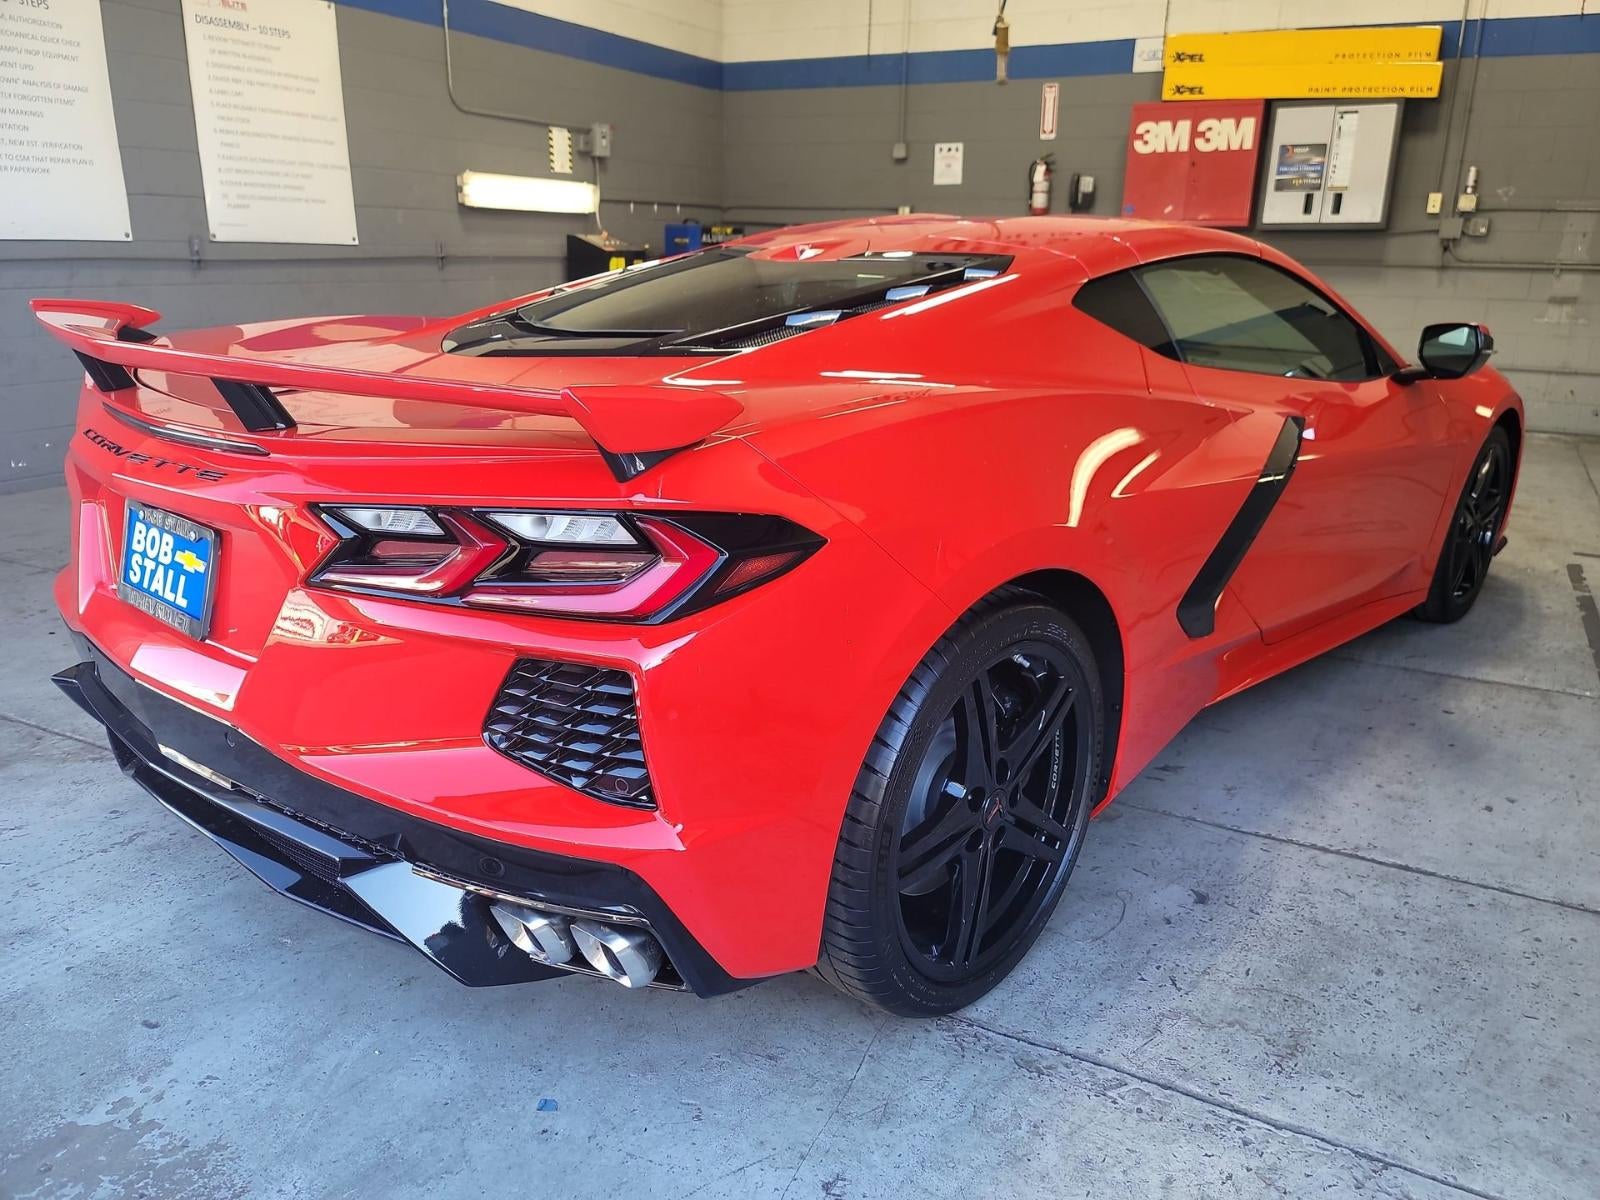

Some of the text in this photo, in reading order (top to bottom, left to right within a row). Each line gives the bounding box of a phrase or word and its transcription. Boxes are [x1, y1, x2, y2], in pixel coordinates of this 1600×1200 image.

[194, 13, 250, 32] DISASSEMBLY
[258, 25, 268, 35] 10
[269, 27, 291, 39] STEPS
[1171, 52, 1205, 63] XPEL
[1334, 52, 1401, 60] PROTECTION
[22, 78, 52, 89] ANALYSIS
[63, 83, 89, 93] DAMAGE
[1171, 85, 1205, 95] XPEL
[13, 93, 53, 104] FORGOTTEN
[8, 108, 44, 118] MARKINGS
[1133, 117, 1256, 154] 3M 3M
[9, 139, 25, 147] NEW
[41, 141, 83, 151] VERIFICATION
[49, 157, 71, 166] REPAIR
[10, 165, 50, 175] PAPERWORK
[83, 429, 229, 482] CORVETTE
[131, 521, 174, 565] BOB
[129, 553, 188, 608] STALL
